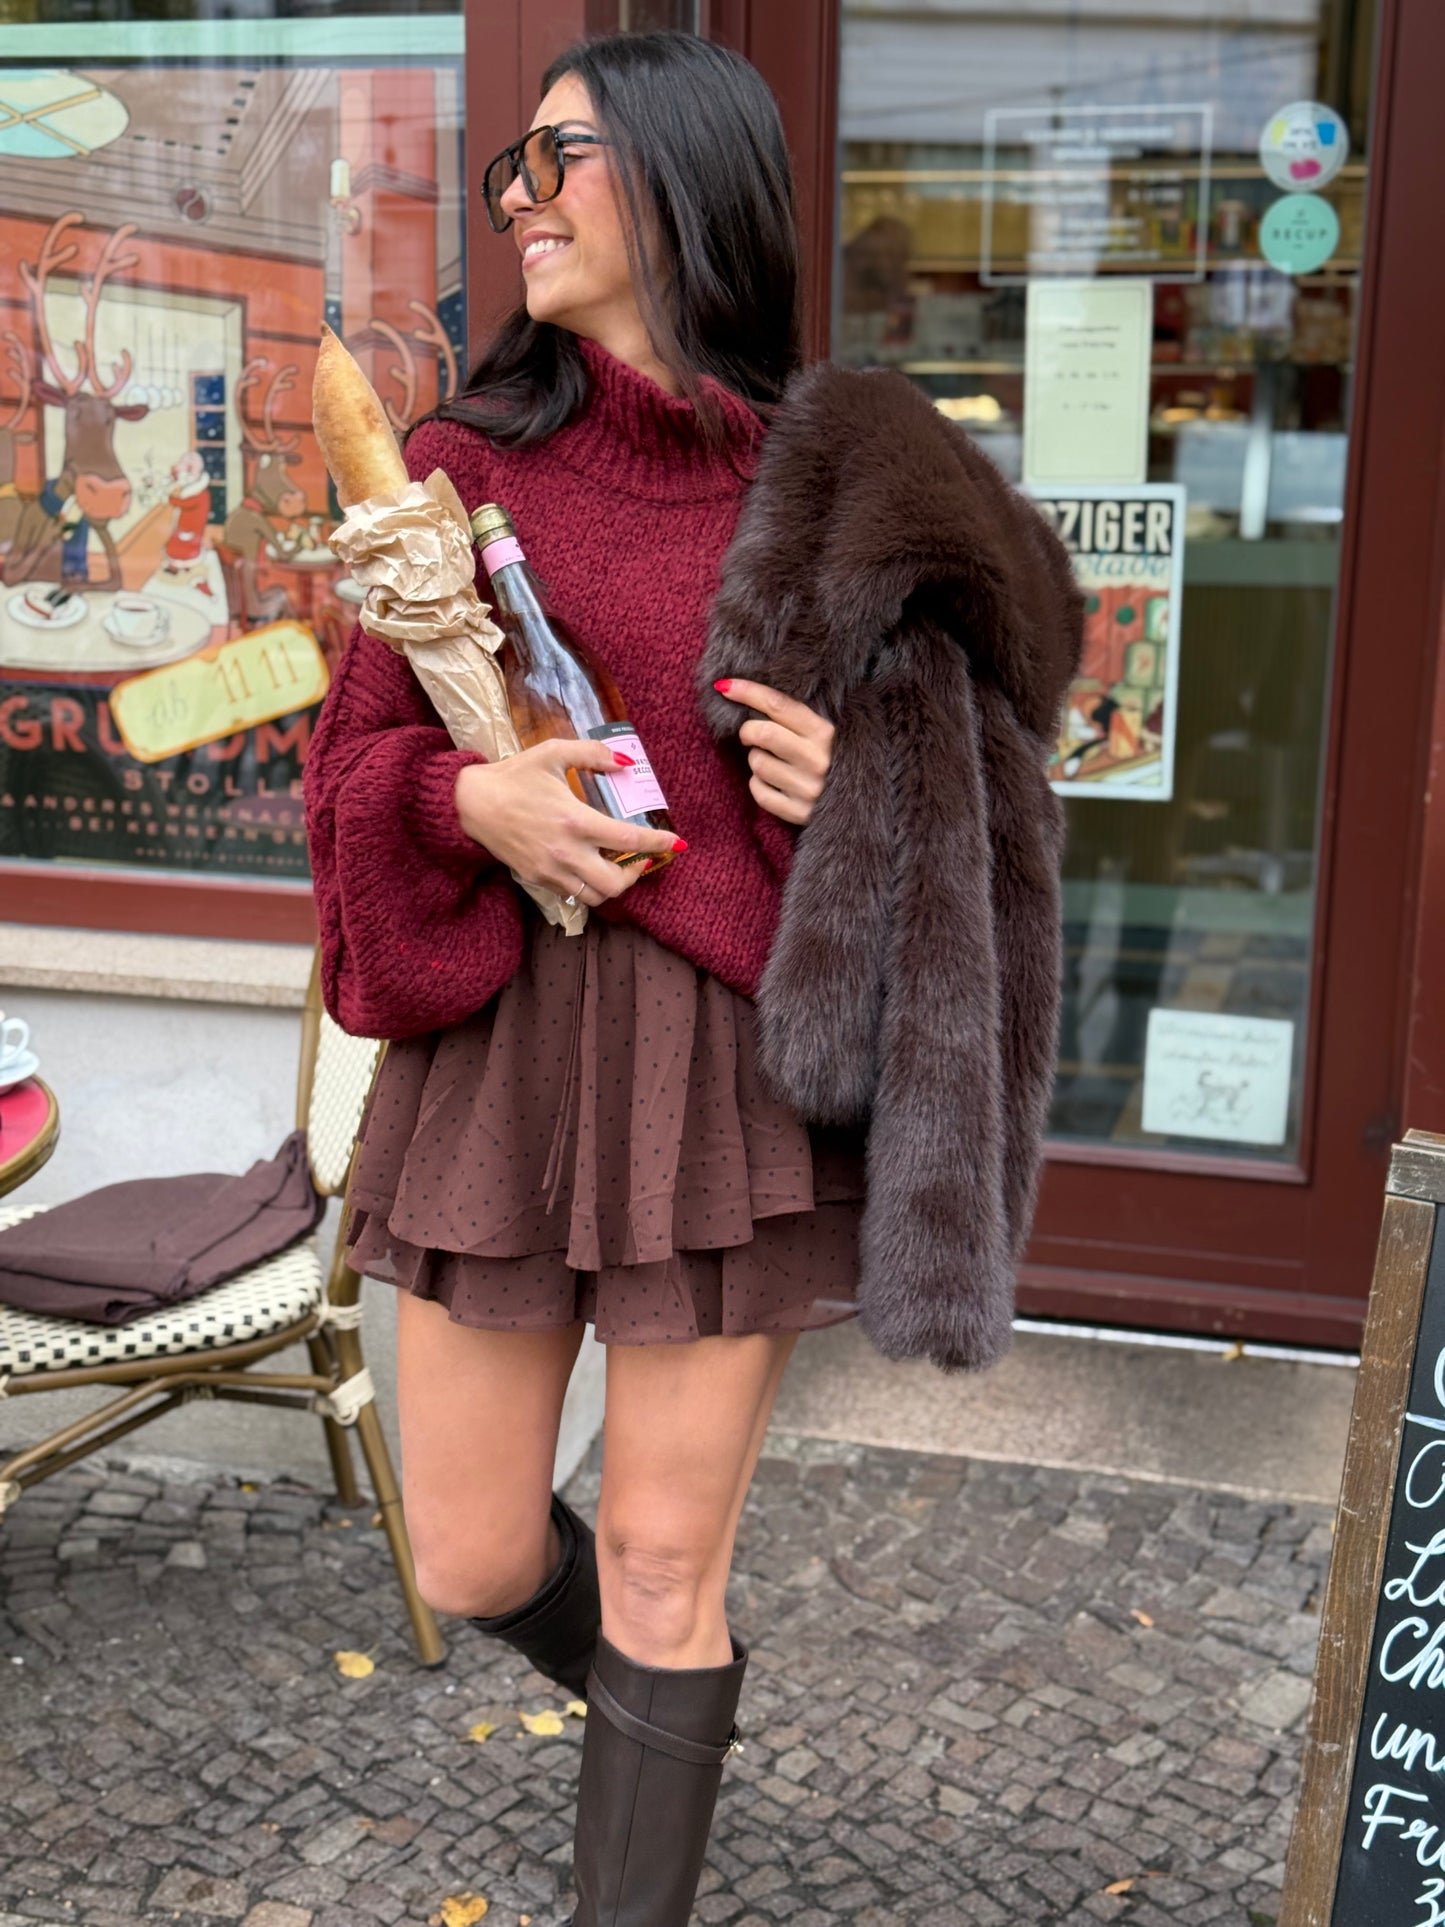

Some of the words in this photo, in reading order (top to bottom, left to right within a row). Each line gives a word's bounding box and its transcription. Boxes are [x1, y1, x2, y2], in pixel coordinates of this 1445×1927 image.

[1273, 227, 1328, 240] RECUP
[0, 695, 312, 764] GRUM
[123, 769, 304, 800] STOLLE
[24, 794, 153, 817] ANDERES
[166, 804, 305, 826] WEIHNAC
[68, 815, 115, 833] BEI
[126, 820, 259, 843] KENNERN
[1379, 1616, 1445, 1690] Ch
[1371, 1712, 1445, 1772] un
